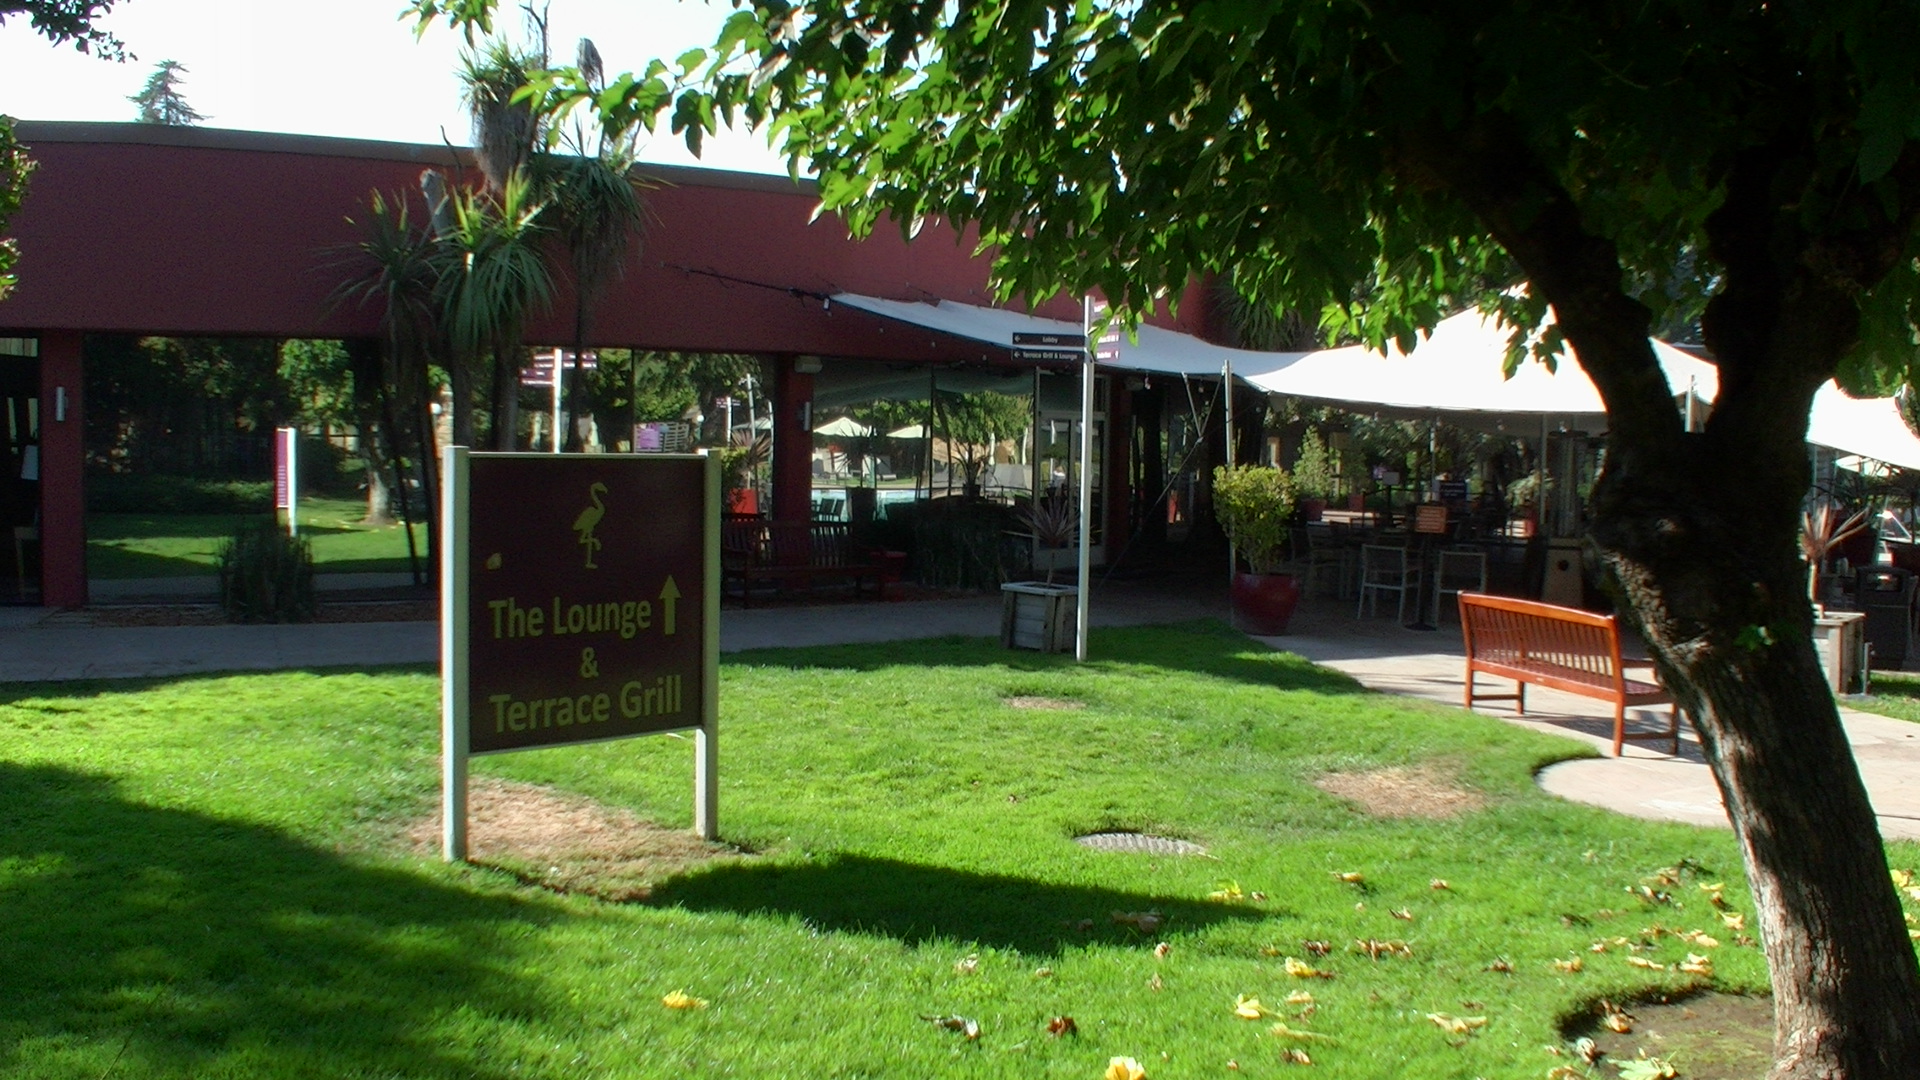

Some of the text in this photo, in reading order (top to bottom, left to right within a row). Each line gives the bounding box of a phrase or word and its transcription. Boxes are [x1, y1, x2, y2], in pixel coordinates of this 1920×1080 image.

[1042, 336, 1058, 344] Lobby
[1059, 353, 1078, 361] Lounge
[488, 596, 652, 640] The Lounge
[580, 646, 599, 679] &
[488, 674, 682, 733] Terrace Grill
